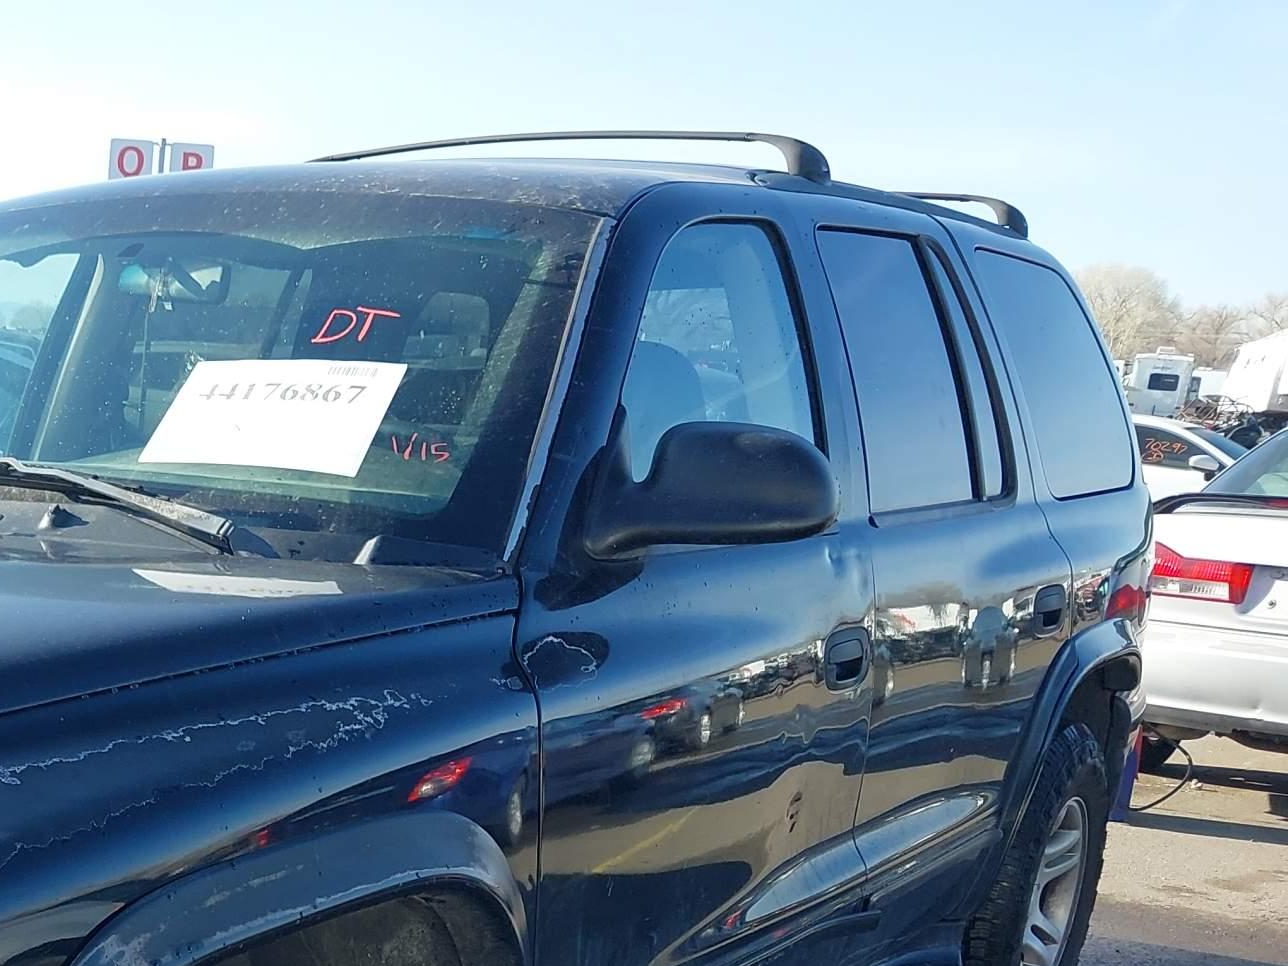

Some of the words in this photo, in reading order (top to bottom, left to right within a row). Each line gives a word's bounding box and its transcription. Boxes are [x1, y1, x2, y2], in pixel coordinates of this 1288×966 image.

[117, 146, 145, 178] O
[310, 306, 402, 343] DT
[198, 382, 368, 404] 44176867
[1144, 438, 1189, 455] 70297
